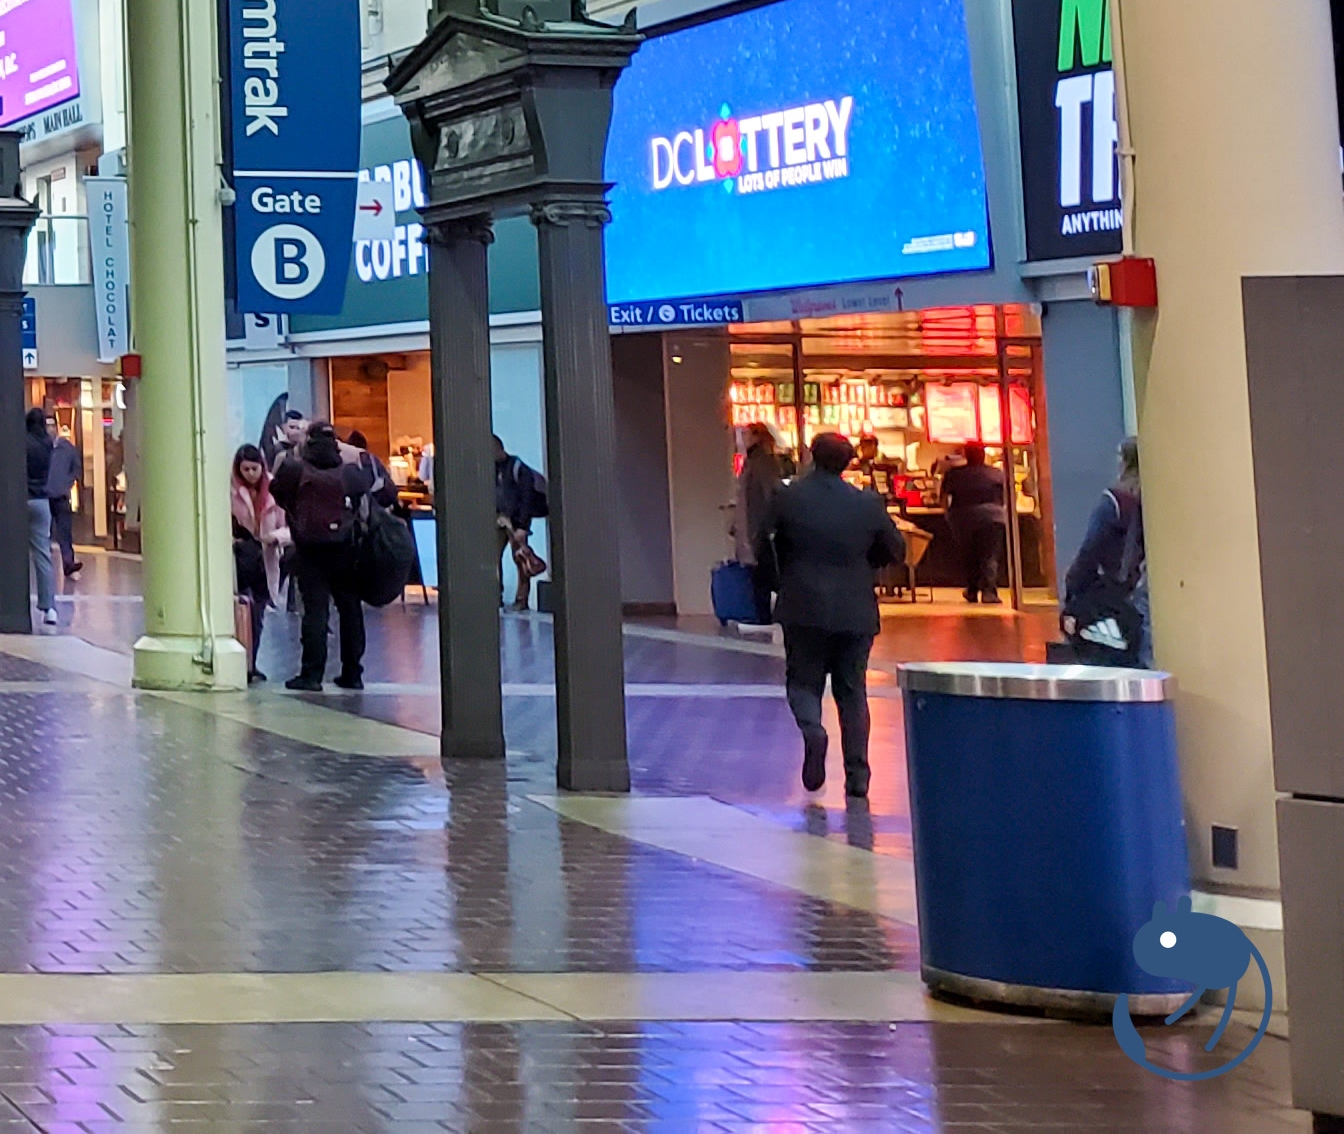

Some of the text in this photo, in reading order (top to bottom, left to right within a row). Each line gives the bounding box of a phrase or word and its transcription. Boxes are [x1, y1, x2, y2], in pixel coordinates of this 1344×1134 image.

[738, 158, 847, 194] LOTS OF PEOPLE WIN
[251, 187, 322, 213] Gate
[103, 191, 117, 349] HOTEL CHOCOLAT
[273, 237, 310, 285] B
[355, 222, 430, 282] COFF
[610, 305, 643, 323] Exit
[679, 303, 739, 321] Tickets
